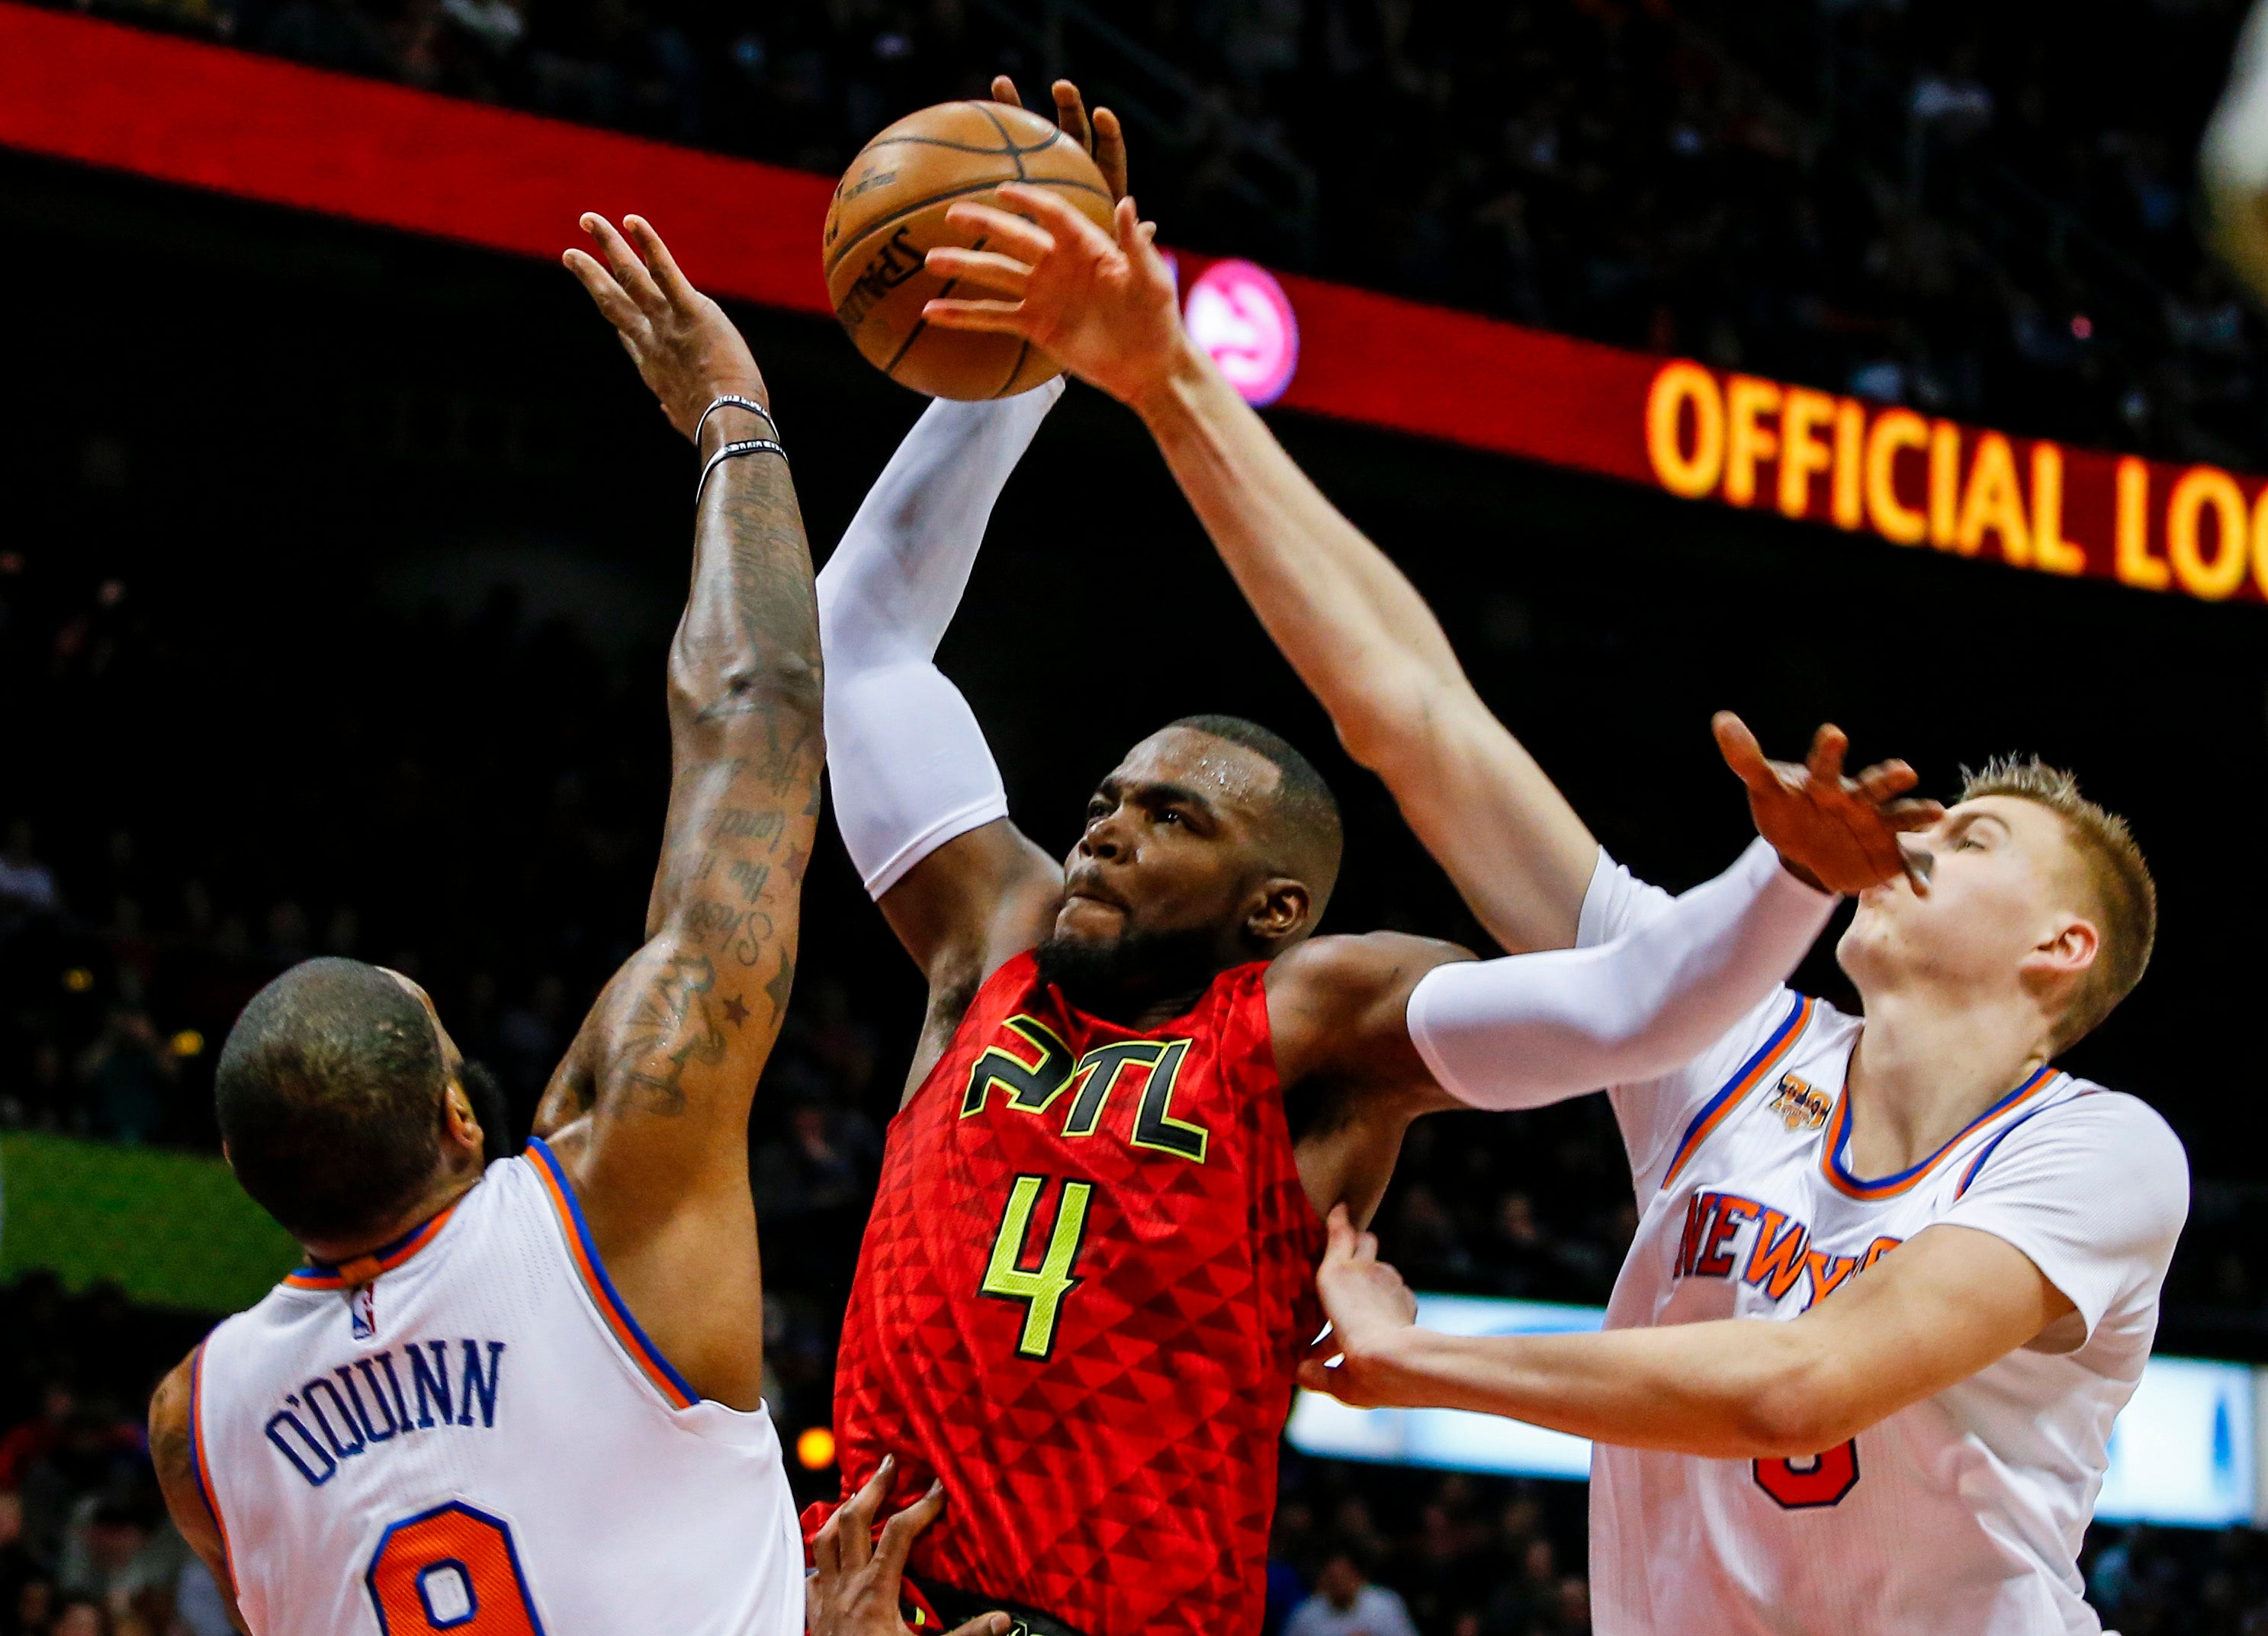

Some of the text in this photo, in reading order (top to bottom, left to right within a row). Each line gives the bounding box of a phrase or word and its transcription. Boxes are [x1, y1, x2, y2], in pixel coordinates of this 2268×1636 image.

[1646, 358, 2268, 601] OFFICIAL LO
[959, 1014, 1209, 1164] ATL
[976, 1172, 1096, 1363] 4
[1672, 1191, 1810, 1303] NEW
[265, 1339, 506, 1487] O'QUINN
